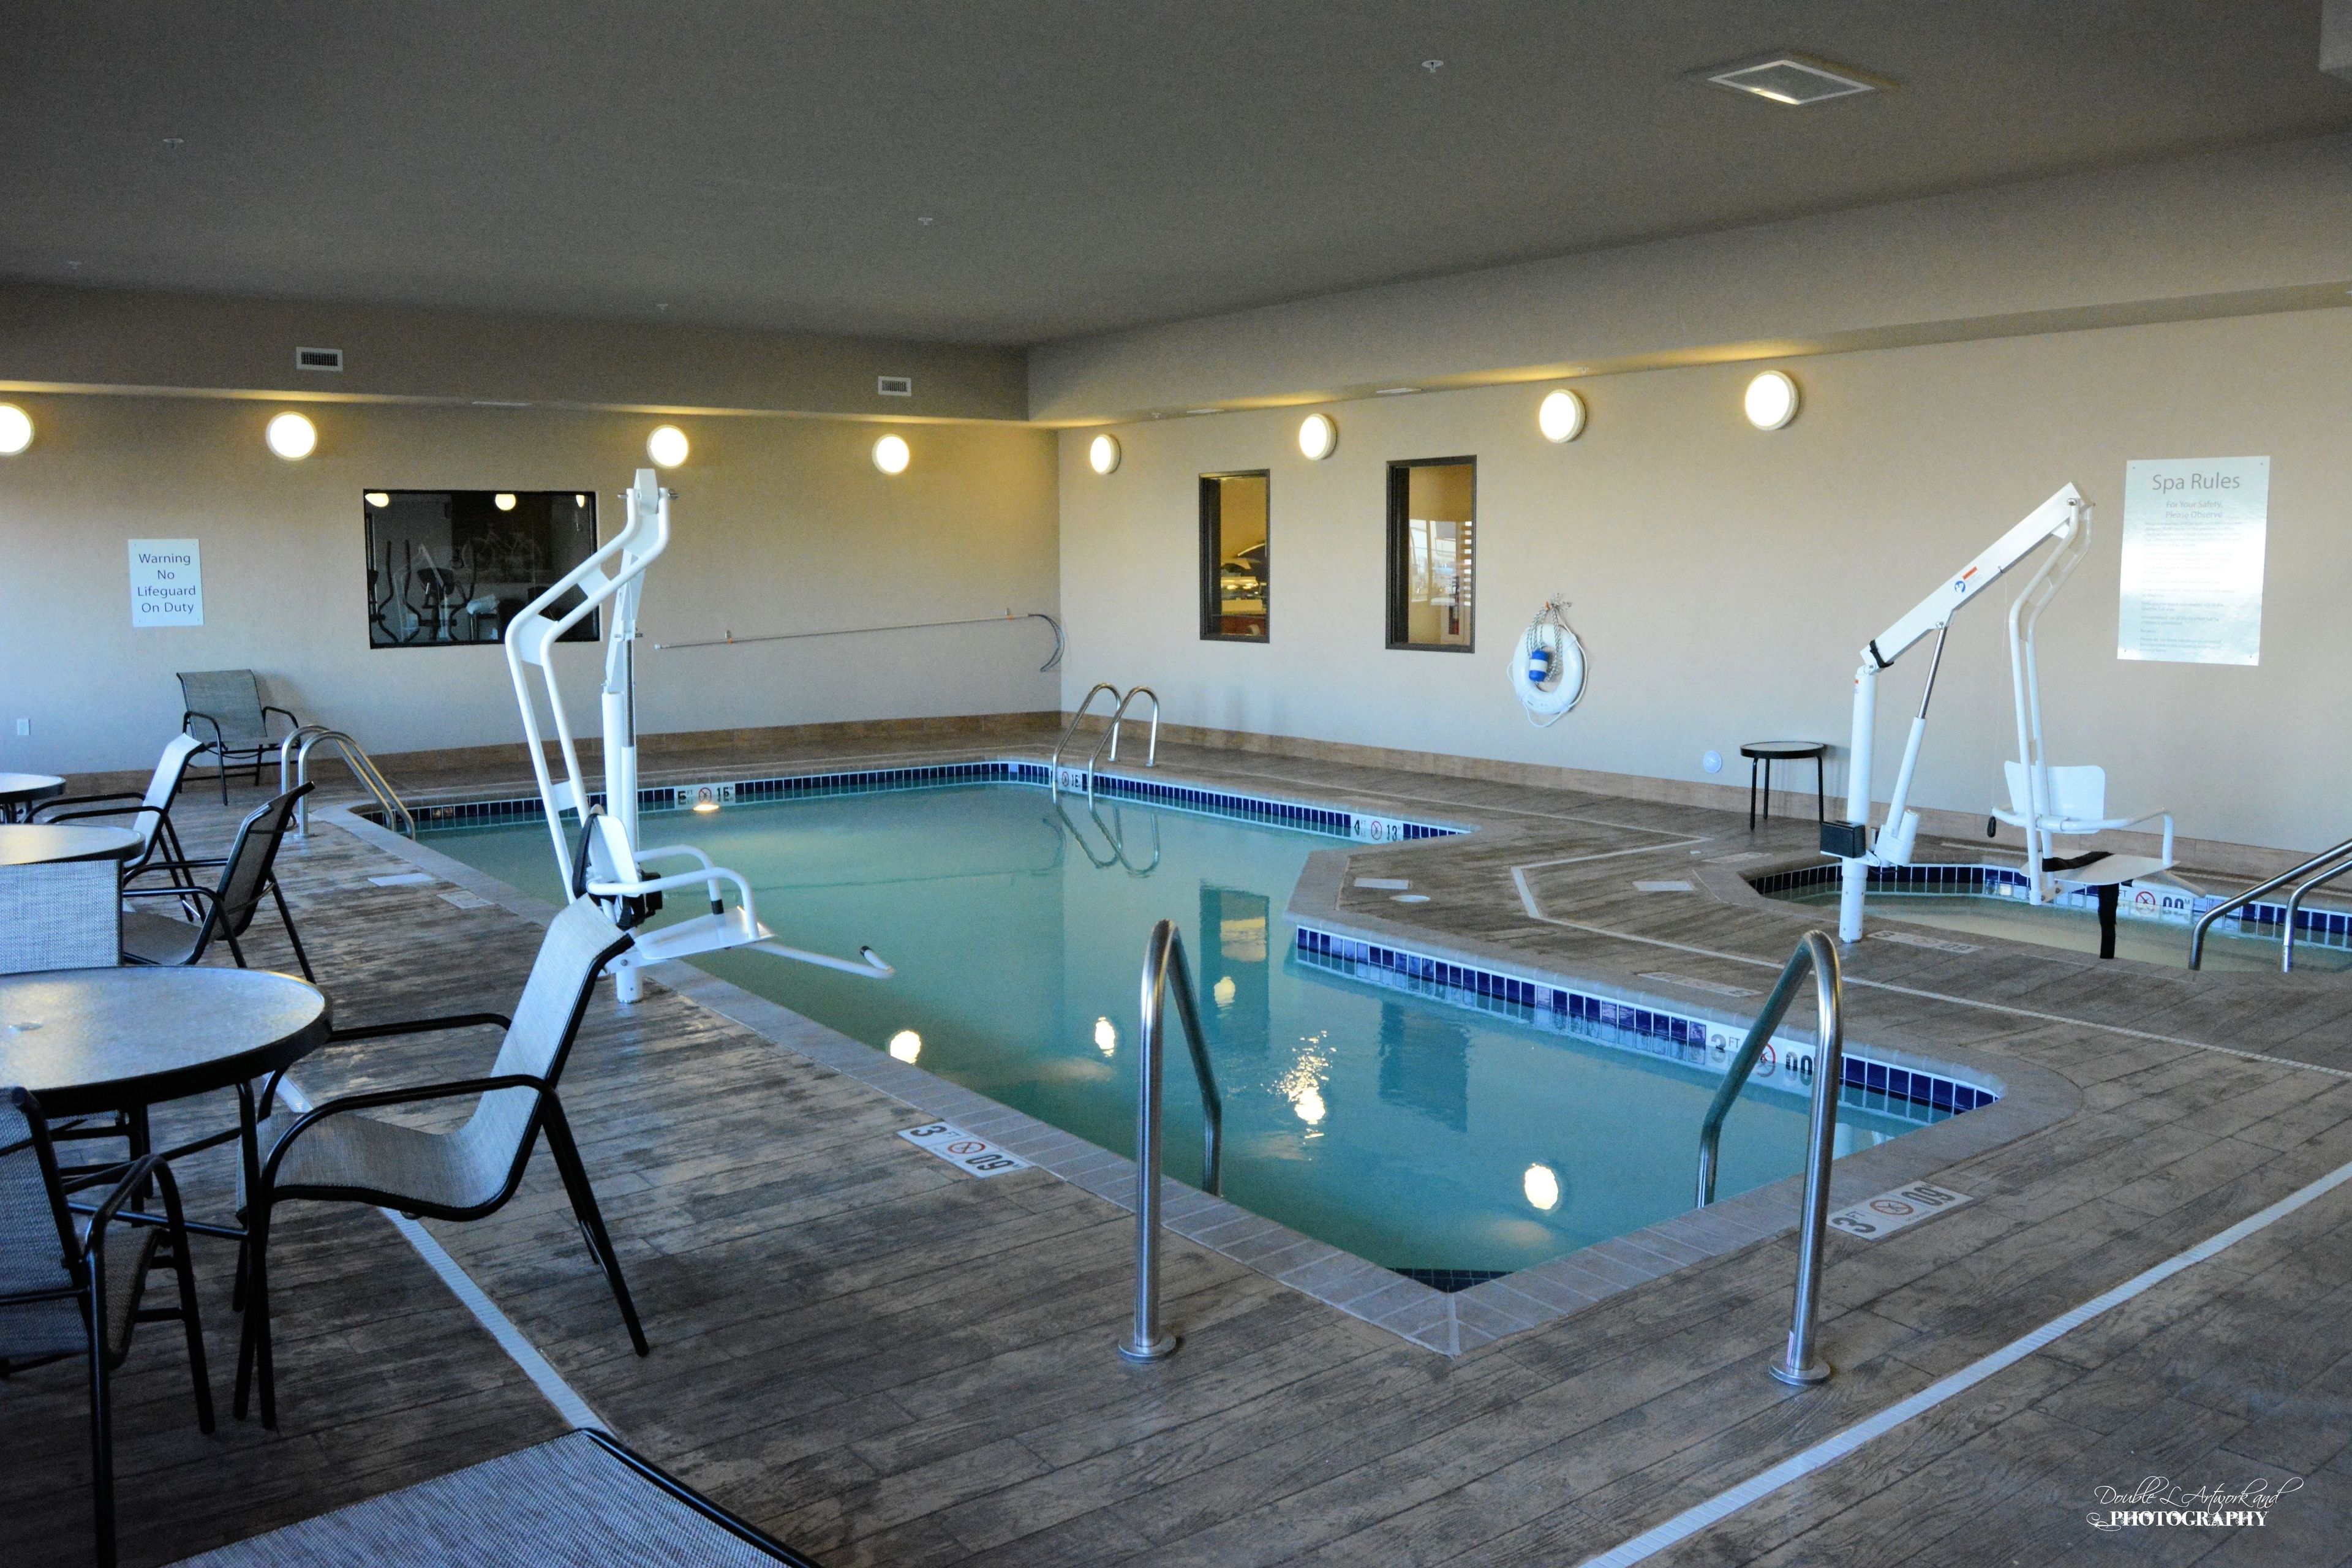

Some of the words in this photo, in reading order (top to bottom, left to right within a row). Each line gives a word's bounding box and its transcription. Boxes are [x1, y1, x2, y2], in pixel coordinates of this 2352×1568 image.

[2152, 474, 2185, 494] Spa
[2191, 472, 2240, 490] Rules
[138, 553, 190, 565] Warning
[157, 570, 175, 579] No
[138, 585, 196, 598] Lifeguard
[141, 603, 159, 612] On
[164, 602, 194, 614] Duty
[1728, 1036, 1741, 1048] FT
[910, 1126, 948, 1137] 3
[1845, 1211, 1866, 1219] FT
[1831, 1217, 1877, 1234] 3
